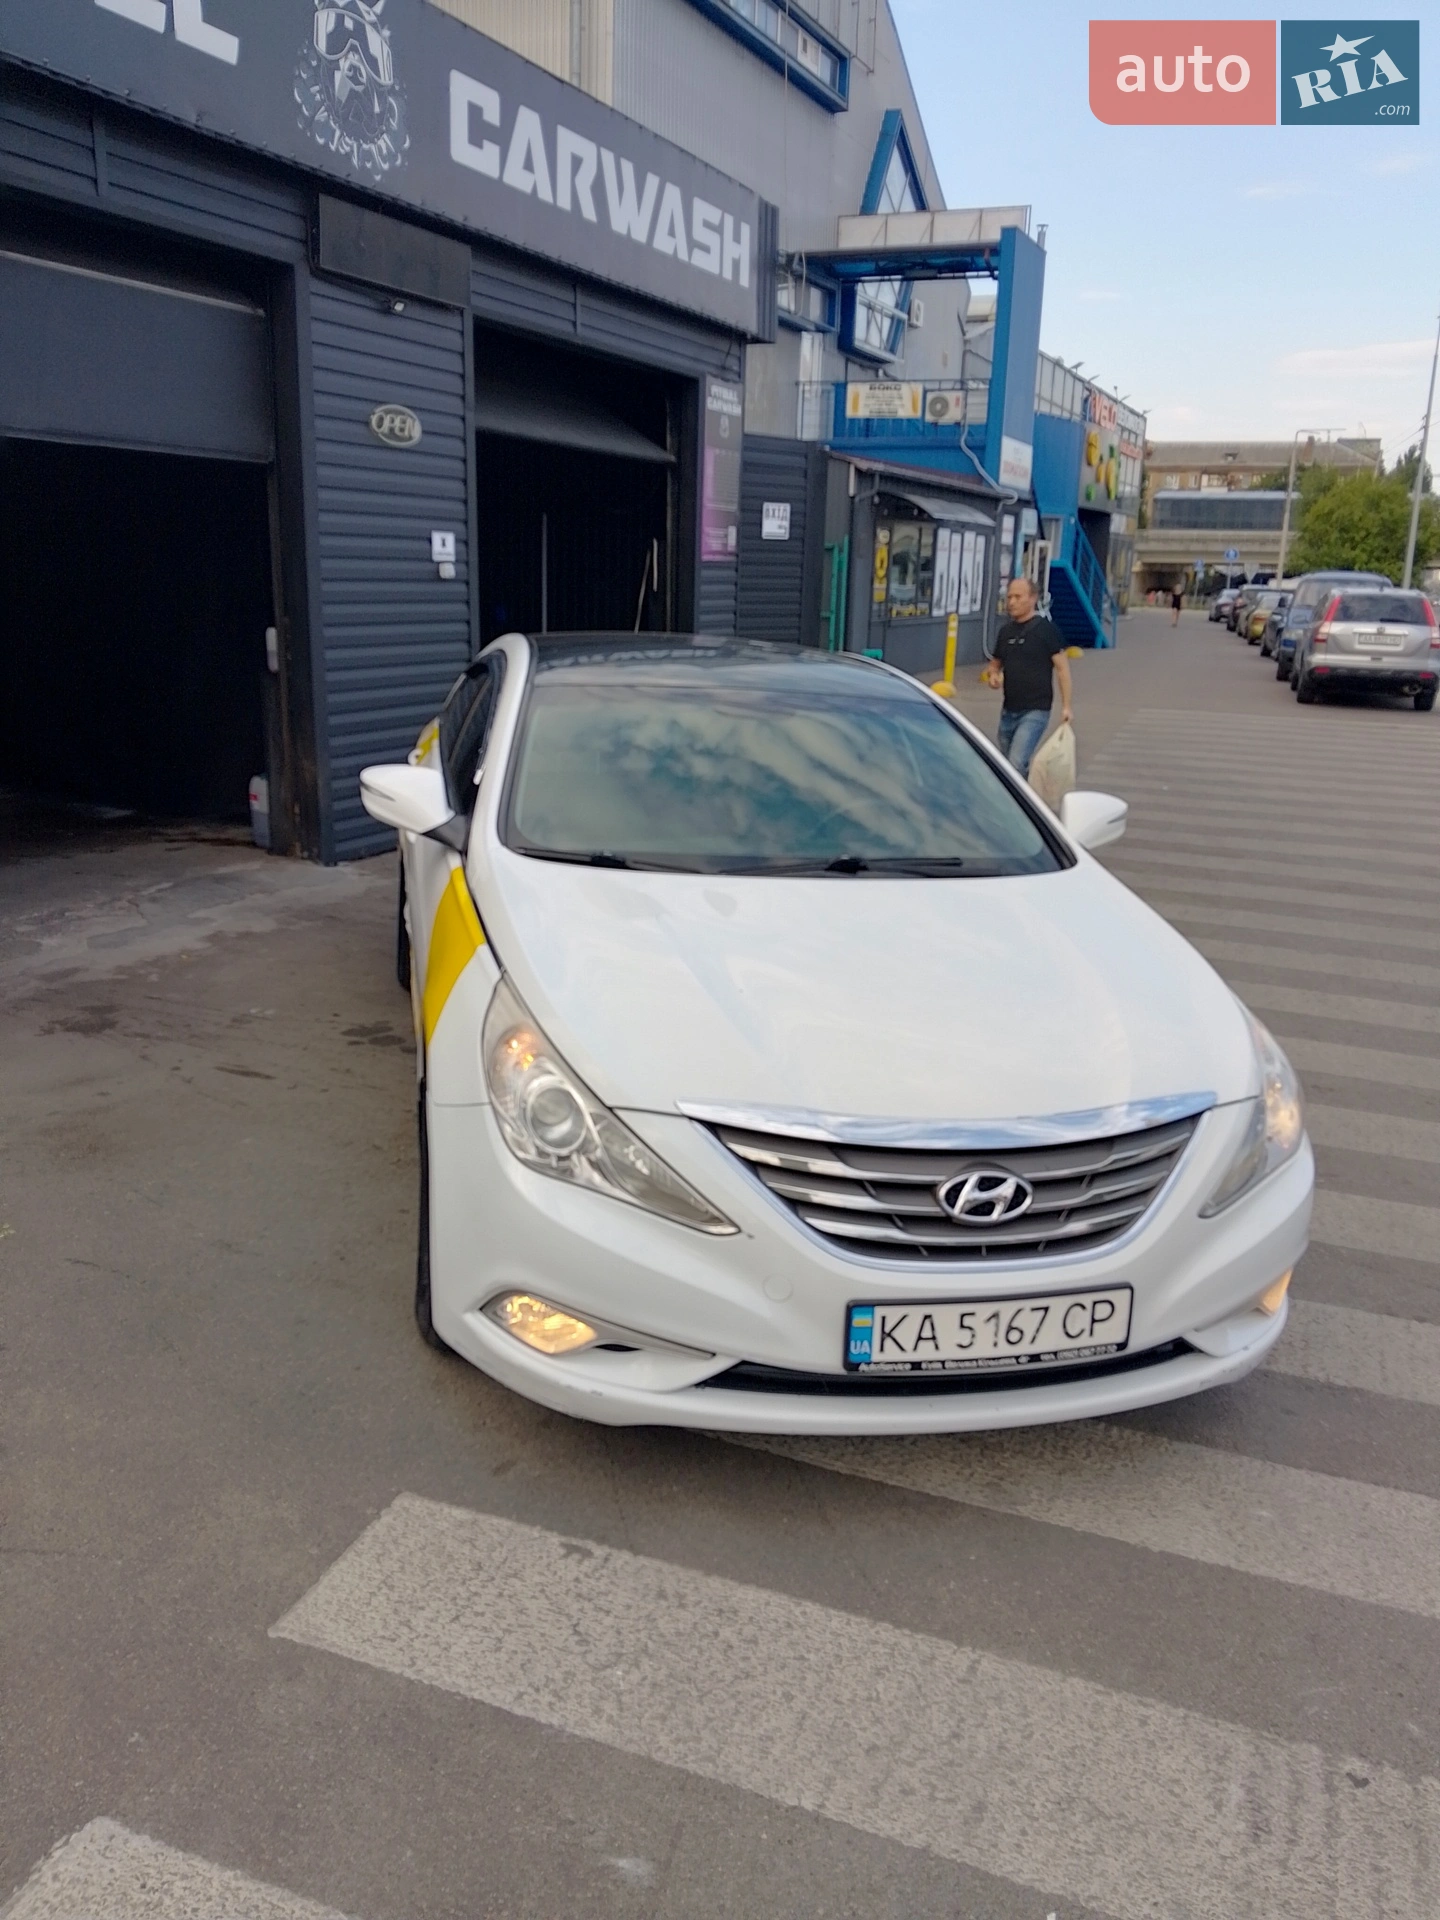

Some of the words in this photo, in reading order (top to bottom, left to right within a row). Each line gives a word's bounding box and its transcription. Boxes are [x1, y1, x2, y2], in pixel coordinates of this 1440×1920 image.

[450, 69, 750, 289] CARWASH
[371, 412, 418, 438] OPEN
[879, 1314, 940, 1353] KA
[956, 1306, 1050, 1350] 5167
[1062, 1299, 1115, 1339] CP
[850, 1340, 870, 1355] UA
